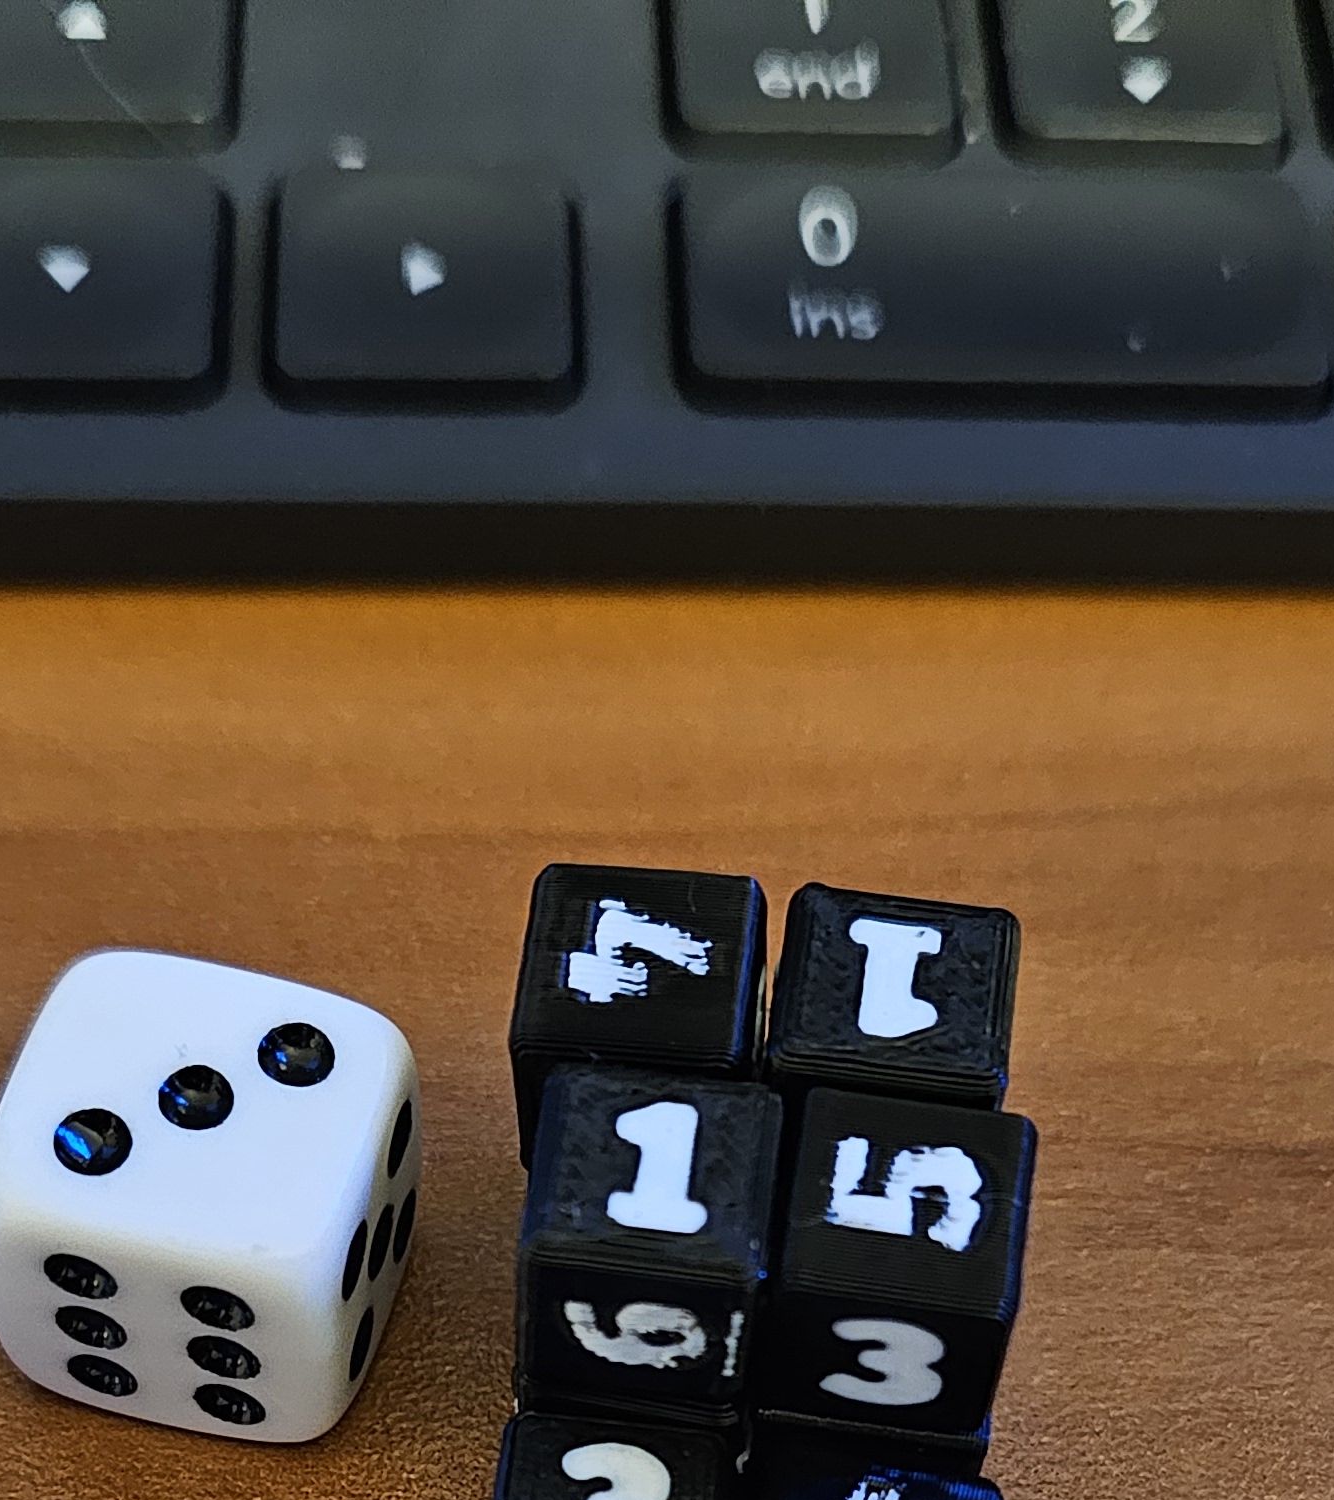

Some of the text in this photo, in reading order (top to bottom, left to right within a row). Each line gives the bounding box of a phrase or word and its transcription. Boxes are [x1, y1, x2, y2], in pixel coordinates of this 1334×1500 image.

[753, 38, 881, 100] end
[798, 183, 858, 267] 0
[788, 282, 884, 340] ins
[568, 899, 714, 1002] 4
[849, 917, 943, 1039] 1
[606, 1101, 708, 1235] 1
[825, 1135, 983, 1253] 5
[819, 1318, 947, 1406] 3
